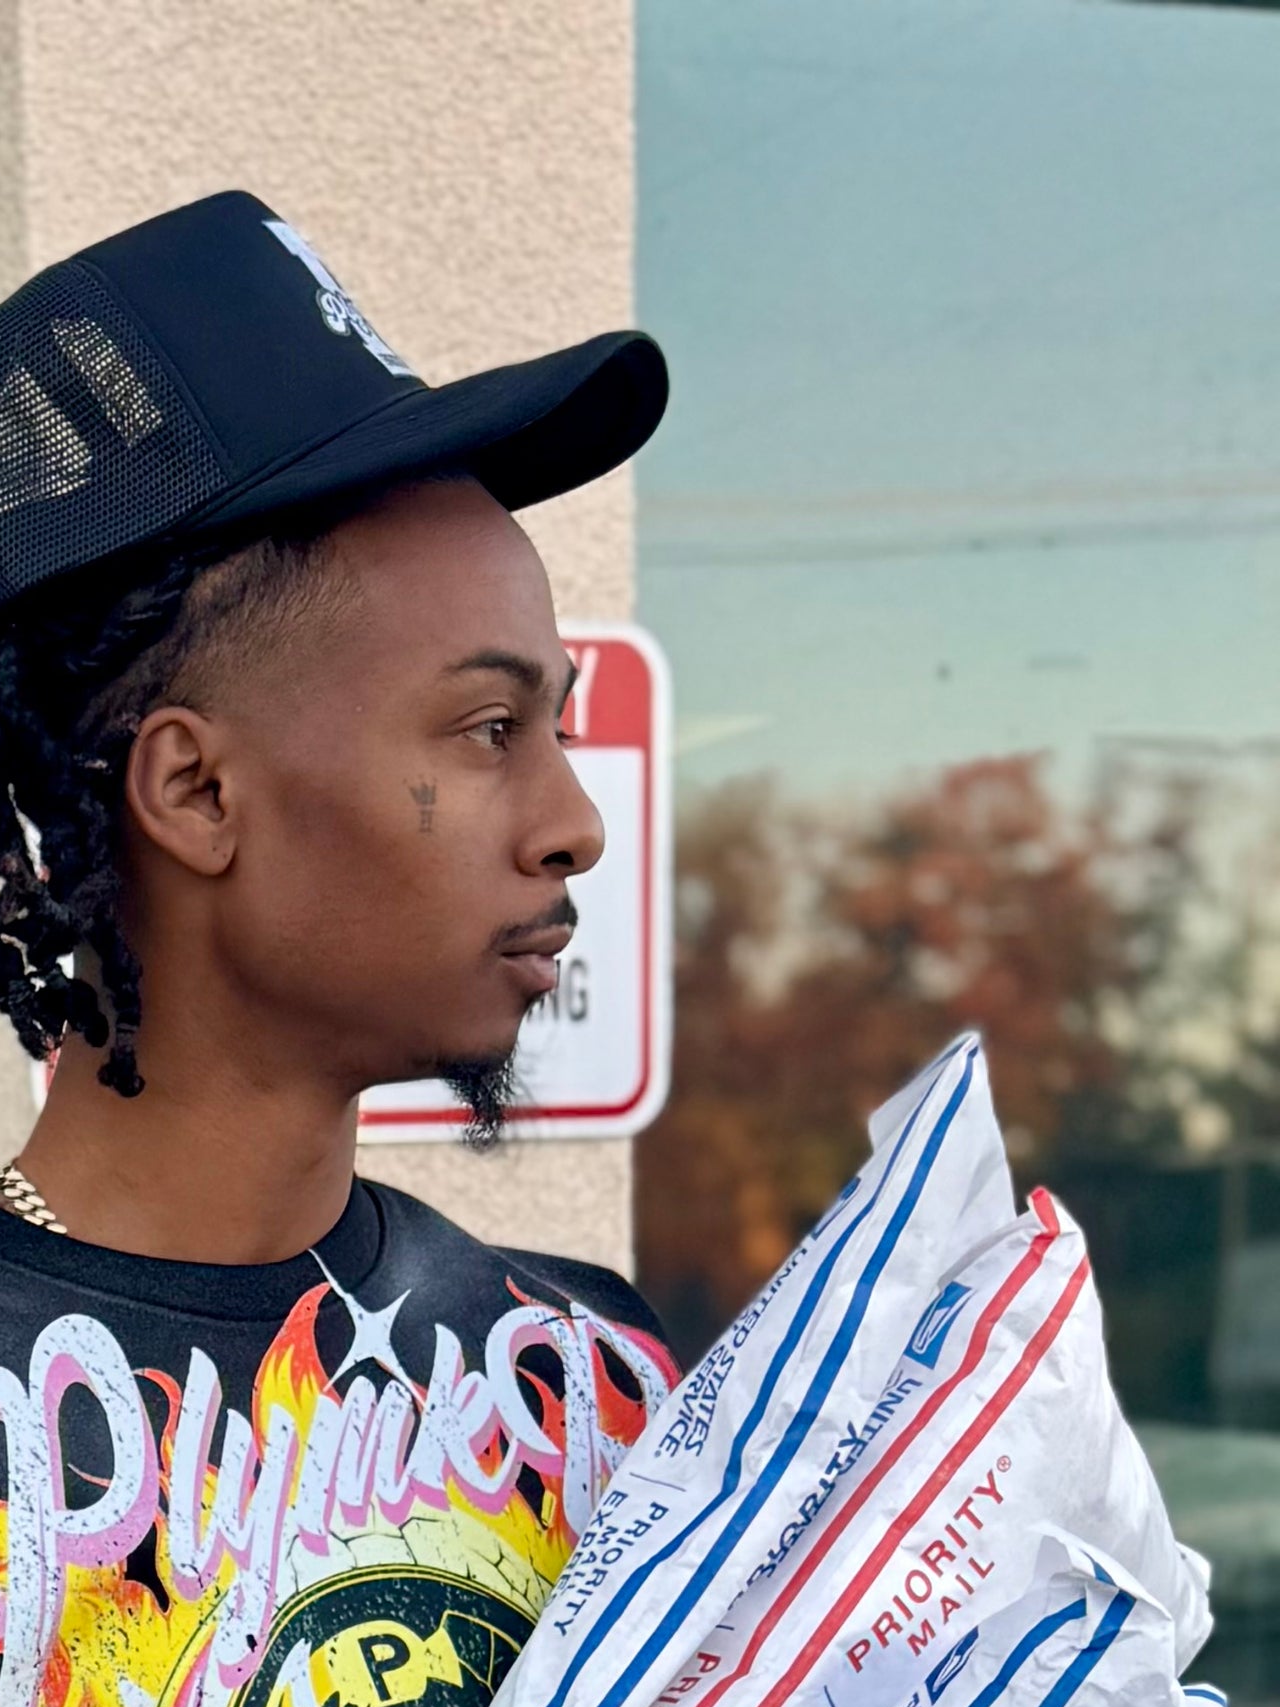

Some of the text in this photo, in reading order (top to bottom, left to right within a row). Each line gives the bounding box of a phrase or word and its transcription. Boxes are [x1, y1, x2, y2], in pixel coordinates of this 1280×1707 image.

[685, 1349, 735, 1457] STATES
[553, 1501, 670, 1637] PRIORITY
[907, 1556, 995, 1657] MAIL
[358, 1633, 412, 1702] P
